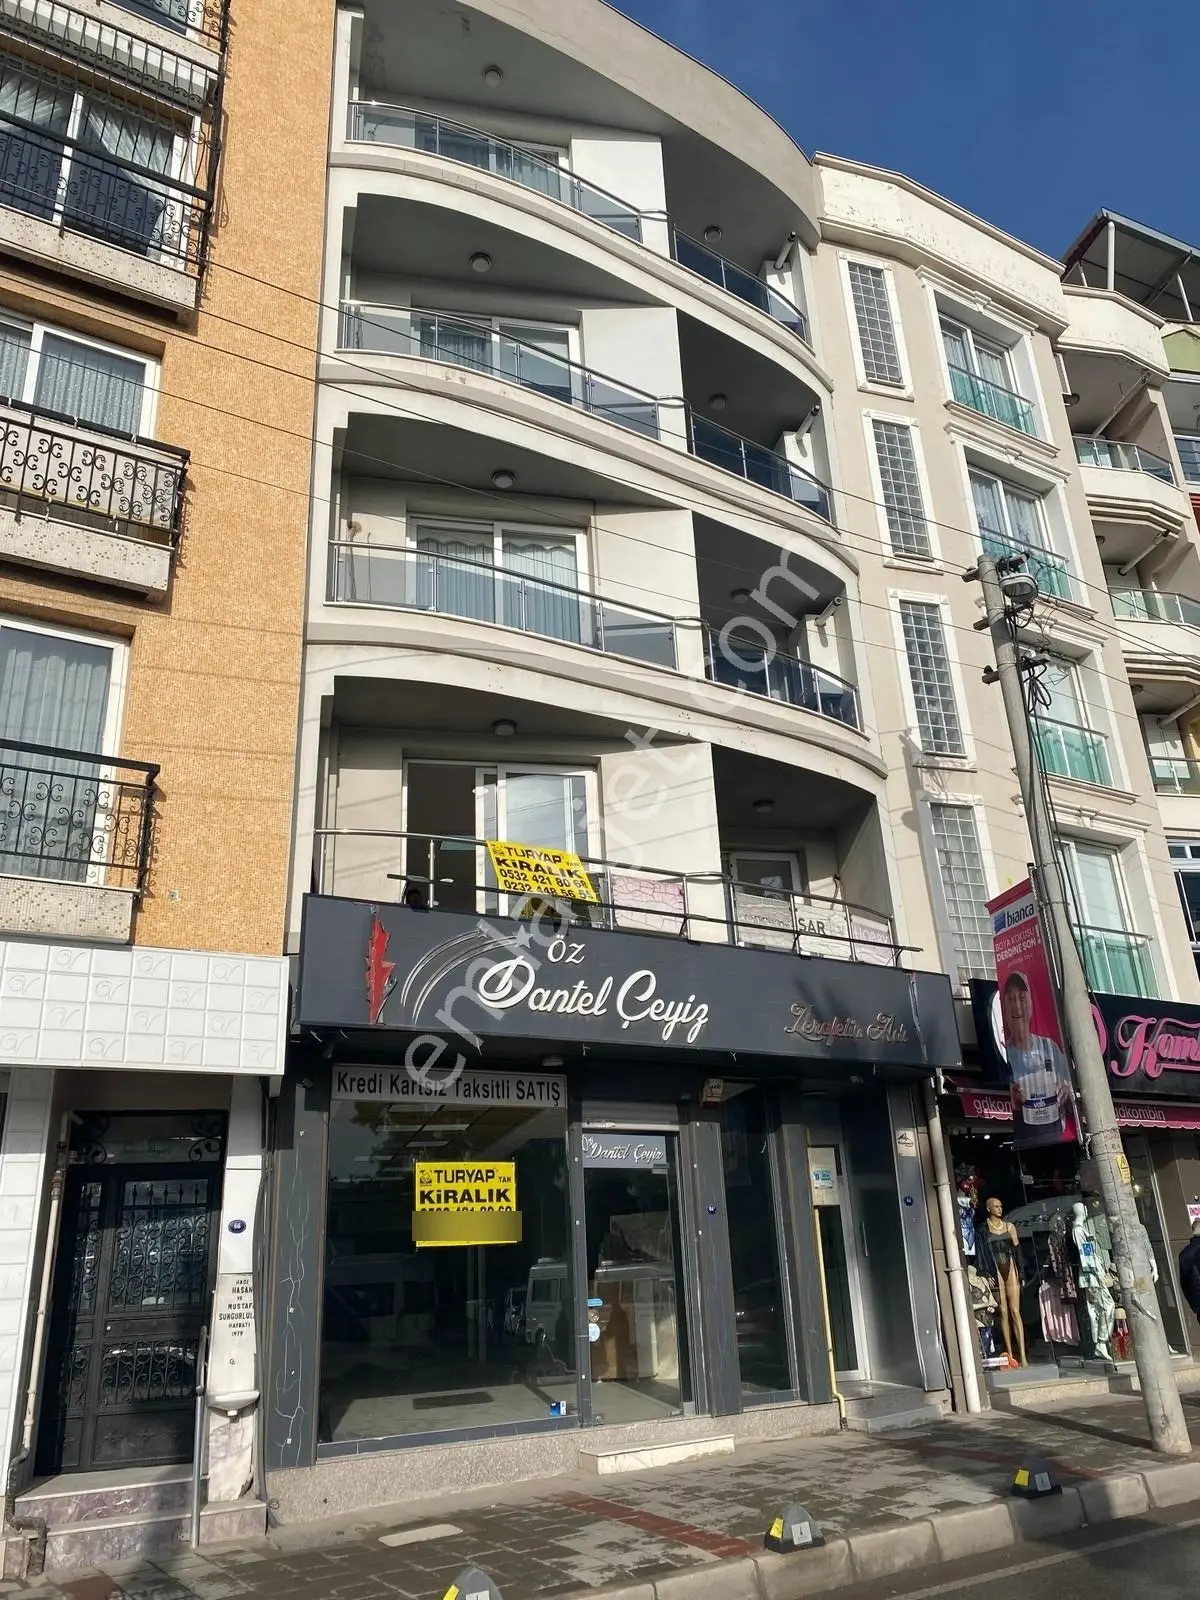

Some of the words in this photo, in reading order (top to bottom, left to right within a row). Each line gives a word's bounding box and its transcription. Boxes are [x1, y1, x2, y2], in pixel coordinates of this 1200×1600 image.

[504, 847, 562, 864] TURYAP
[500, 869, 528, 880] 0532
[532, 875, 552, 885] 421
[556, 878, 570, 887] 80
[504, 880, 531, 892] 0232
[1006, 904, 1035, 927] bianca
[477, 955, 613, 1015] Dantel
[616, 969, 710, 1044] Çeyiz
[1111, 1014, 1200, 1078] Kom
[337, 1071, 383, 1094] Kredi
[455, 1077, 510, 1099] Taksitli
[516, 1079, 561, 1106] SATIŞ
[586, 1143, 631, 1160] Dantel
[634, 1144, 664, 1164] Çeyiz
[434, 1169, 495, 1184] TURYAP
[232, 1286, 253, 1294] HASAN
